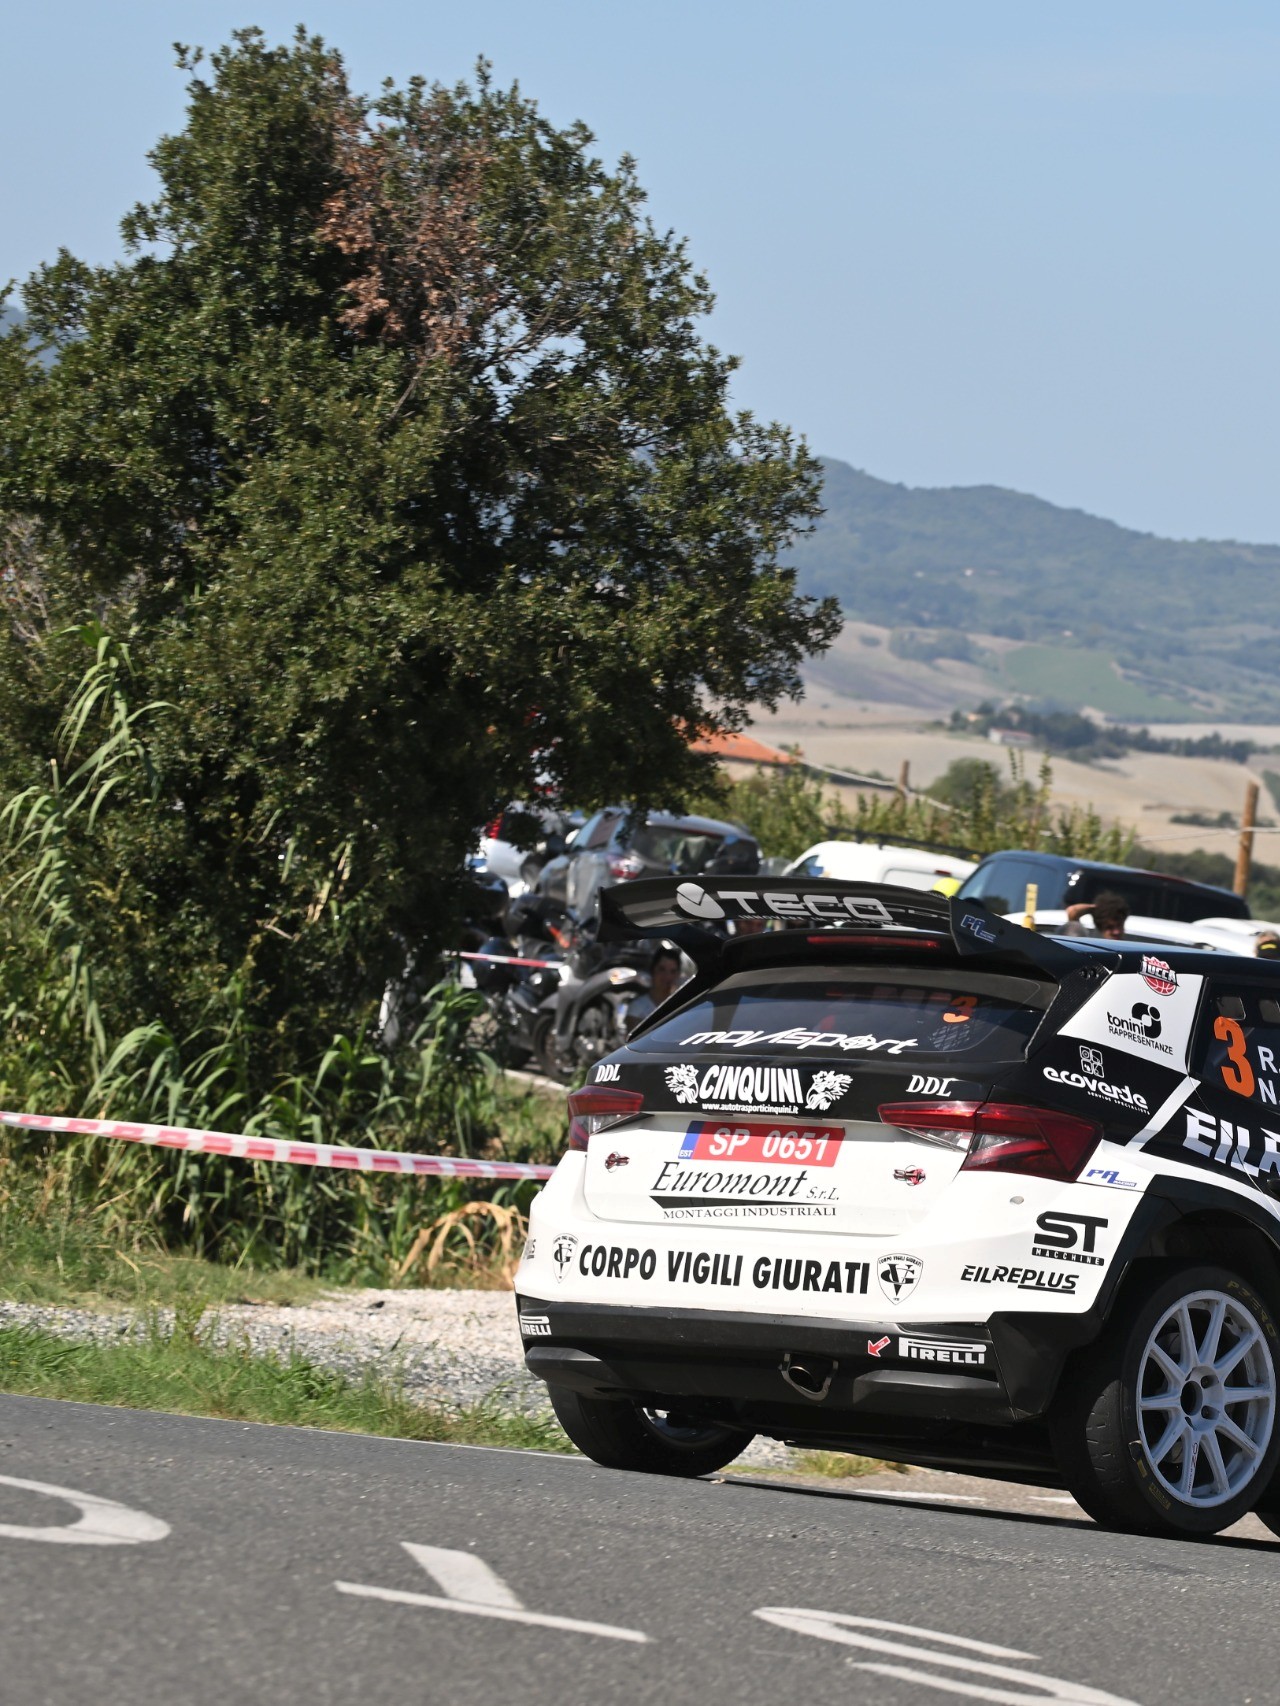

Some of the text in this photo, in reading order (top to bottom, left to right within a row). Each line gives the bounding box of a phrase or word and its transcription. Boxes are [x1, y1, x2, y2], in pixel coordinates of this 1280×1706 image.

[1107, 1011, 1145, 1036] tonini
[1108, 1025, 1174, 1055] RAPPRESENTANZE
[1213, 1016, 1255, 1098] 3
[594, 1064, 621, 1083] DDL
[699, 1065, 804, 1104] CINQUINI
[905, 1074, 953, 1097] DDL
[1043, 1066, 1149, 1110] ecoverde
[701, 1103, 799, 1115] www.autotrasporticinquini.it
[678, 1149, 694, 1158] EST
[709, 1127, 832, 1161] SP 0651
[650, 1161, 809, 1197] Euromont
[663, 1206, 836, 1220] MONTAGGI INDUSTRIALI
[1034, 1210, 1108, 1253] ST
[579, 1244, 657, 1280] CORPO
[668, 1250, 743, 1286] VIGILI
[752, 1256, 870, 1294] GIURATI
[1034, 1247, 1101, 1266] MACCHINE
[960, 1265, 1079, 1290] EILREPLUS
[899, 1337, 987, 1365] PIRELLI
